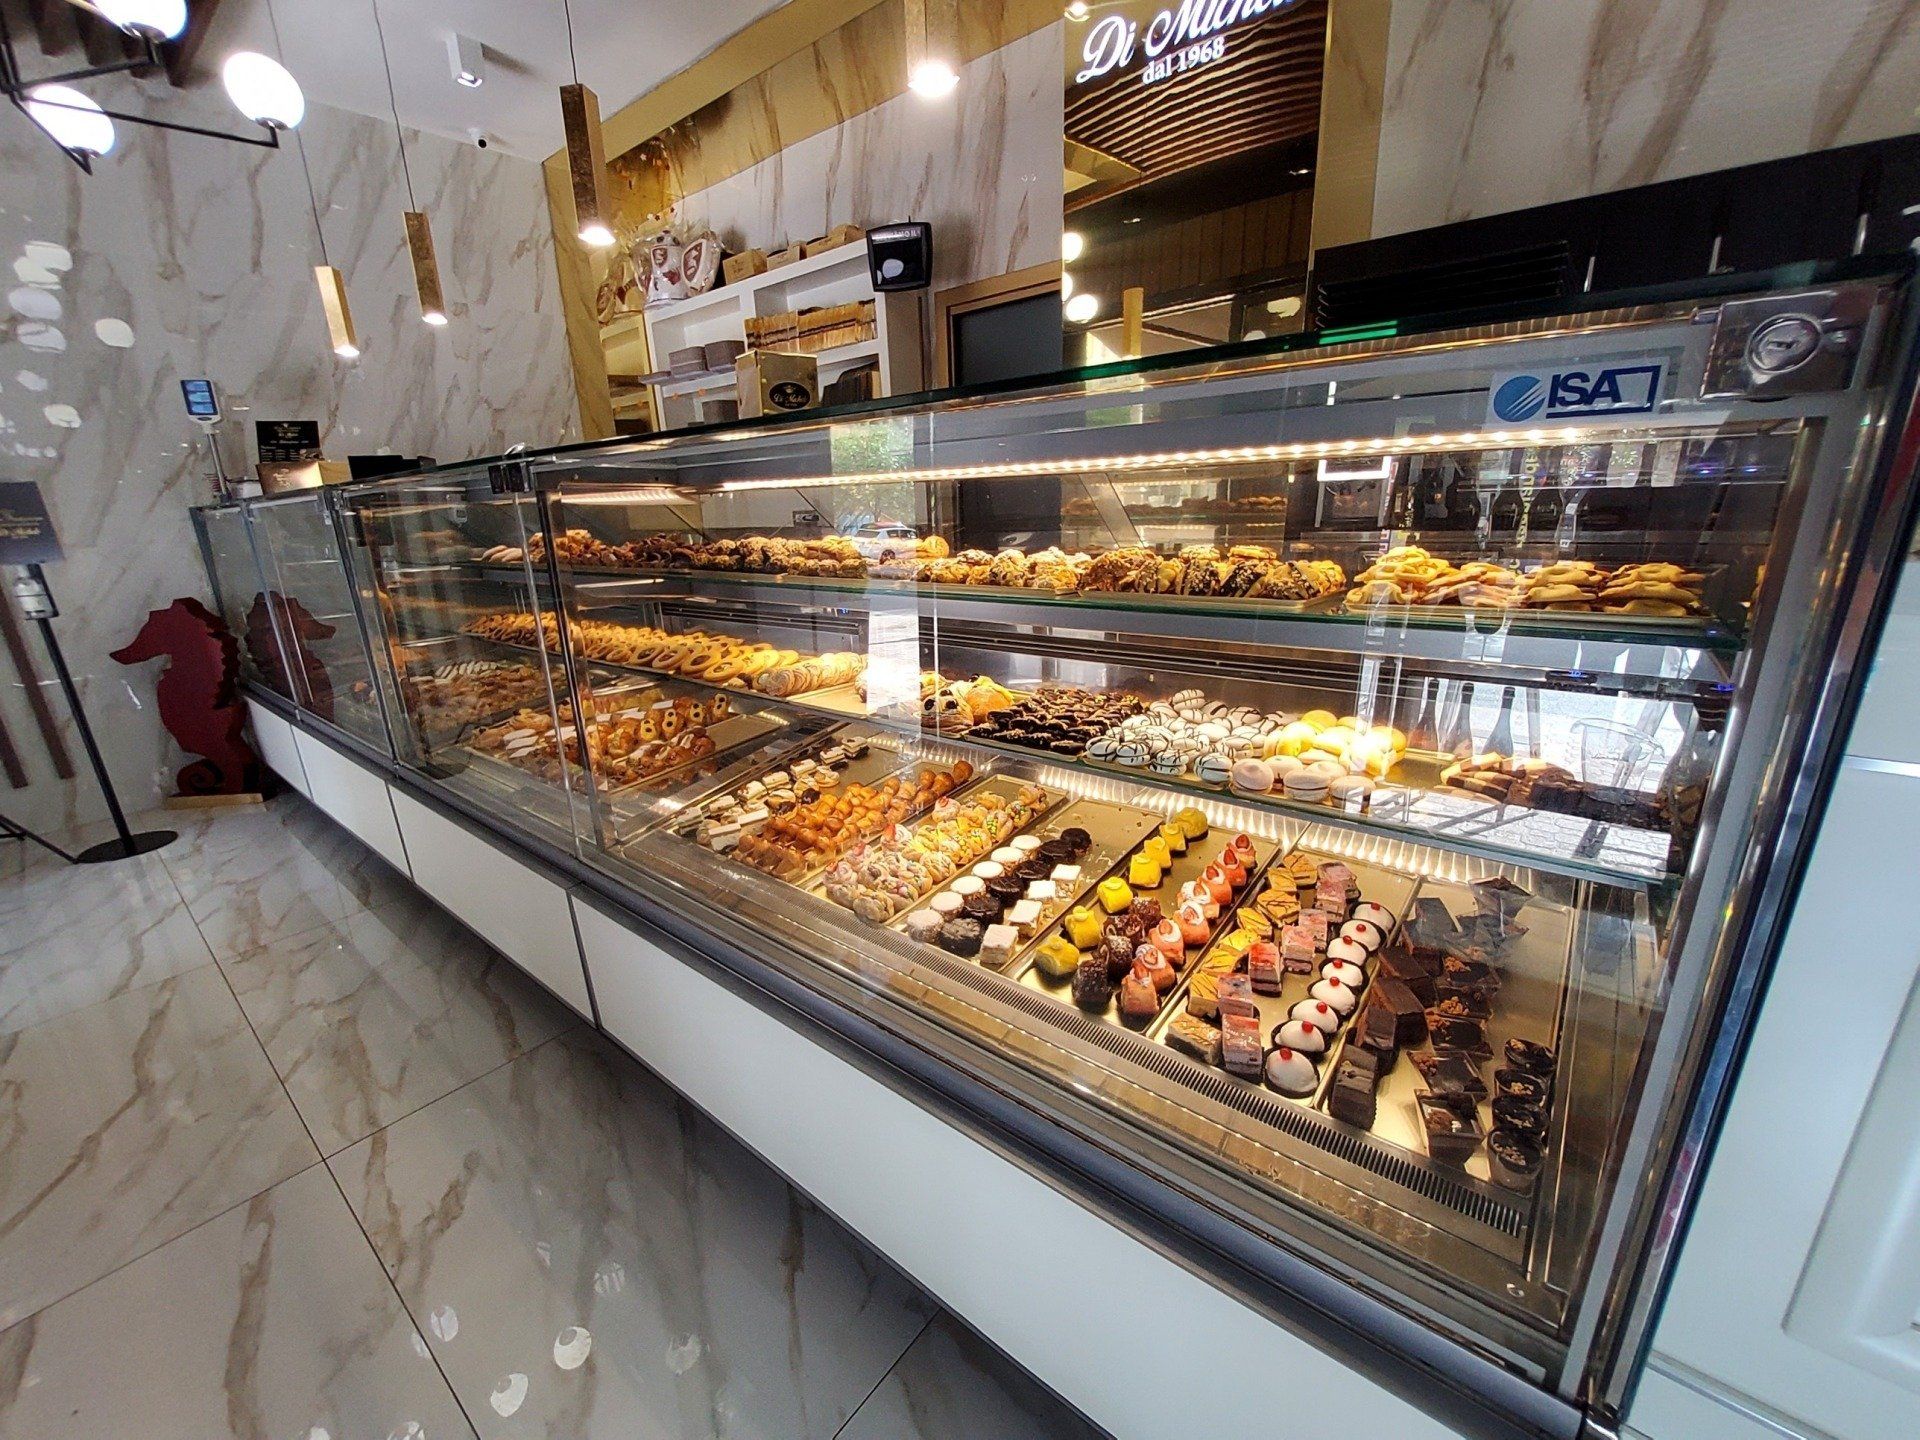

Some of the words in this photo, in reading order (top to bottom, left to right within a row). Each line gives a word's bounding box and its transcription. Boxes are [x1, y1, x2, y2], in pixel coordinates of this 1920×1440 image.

[1076, 16, 1136, 84] Di
[1142, 55, 1174, 85] dal
[1177, 36, 1226, 71] 1968
[1548, 370, 1622, 408] ISA
